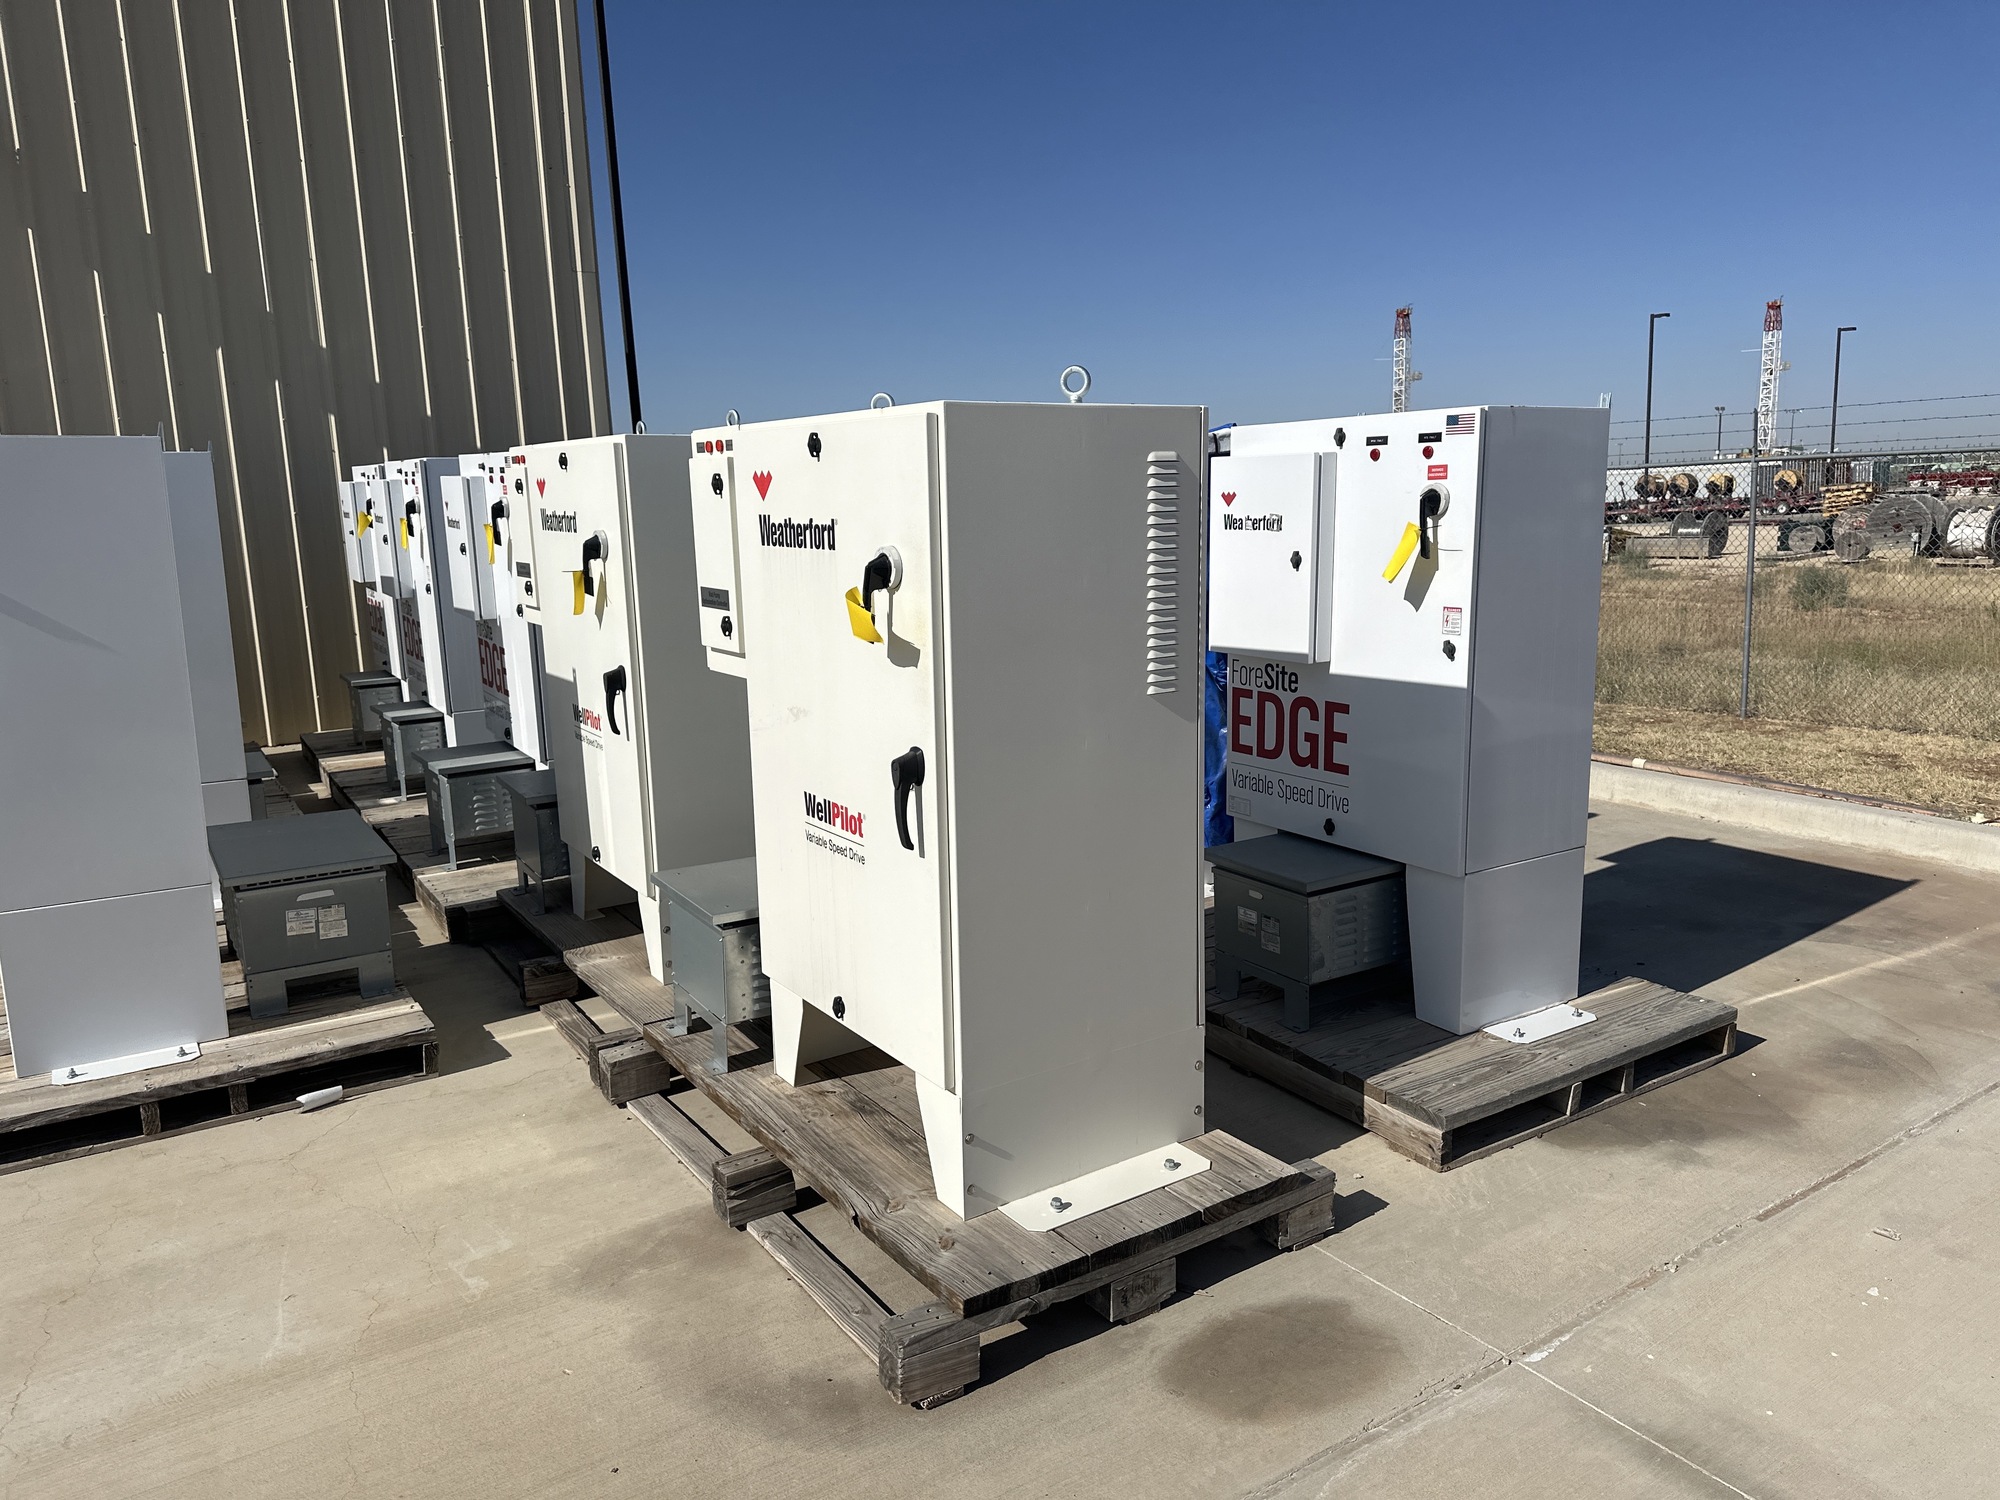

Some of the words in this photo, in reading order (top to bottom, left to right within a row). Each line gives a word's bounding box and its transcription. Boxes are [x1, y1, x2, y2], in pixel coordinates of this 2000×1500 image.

[539, 507, 577, 534] Weatherford
[758, 513, 836, 551] Weatherford
[478, 637, 509, 698] EDGE
[1231, 658, 1299, 694] ForeSite
[572, 703, 602, 732] WellPilot
[1231, 687, 1350, 776] EDGE
[1231, 768, 1274, 796] Variable
[1277, 778, 1314, 806] Speed
[1318, 786, 1350, 814] Drive
[803, 790, 864, 839] WellPilot
[805, 829, 828, 849] Variable
[828, 838, 848, 858] Speed
[848, 847, 866, 865] Drive
